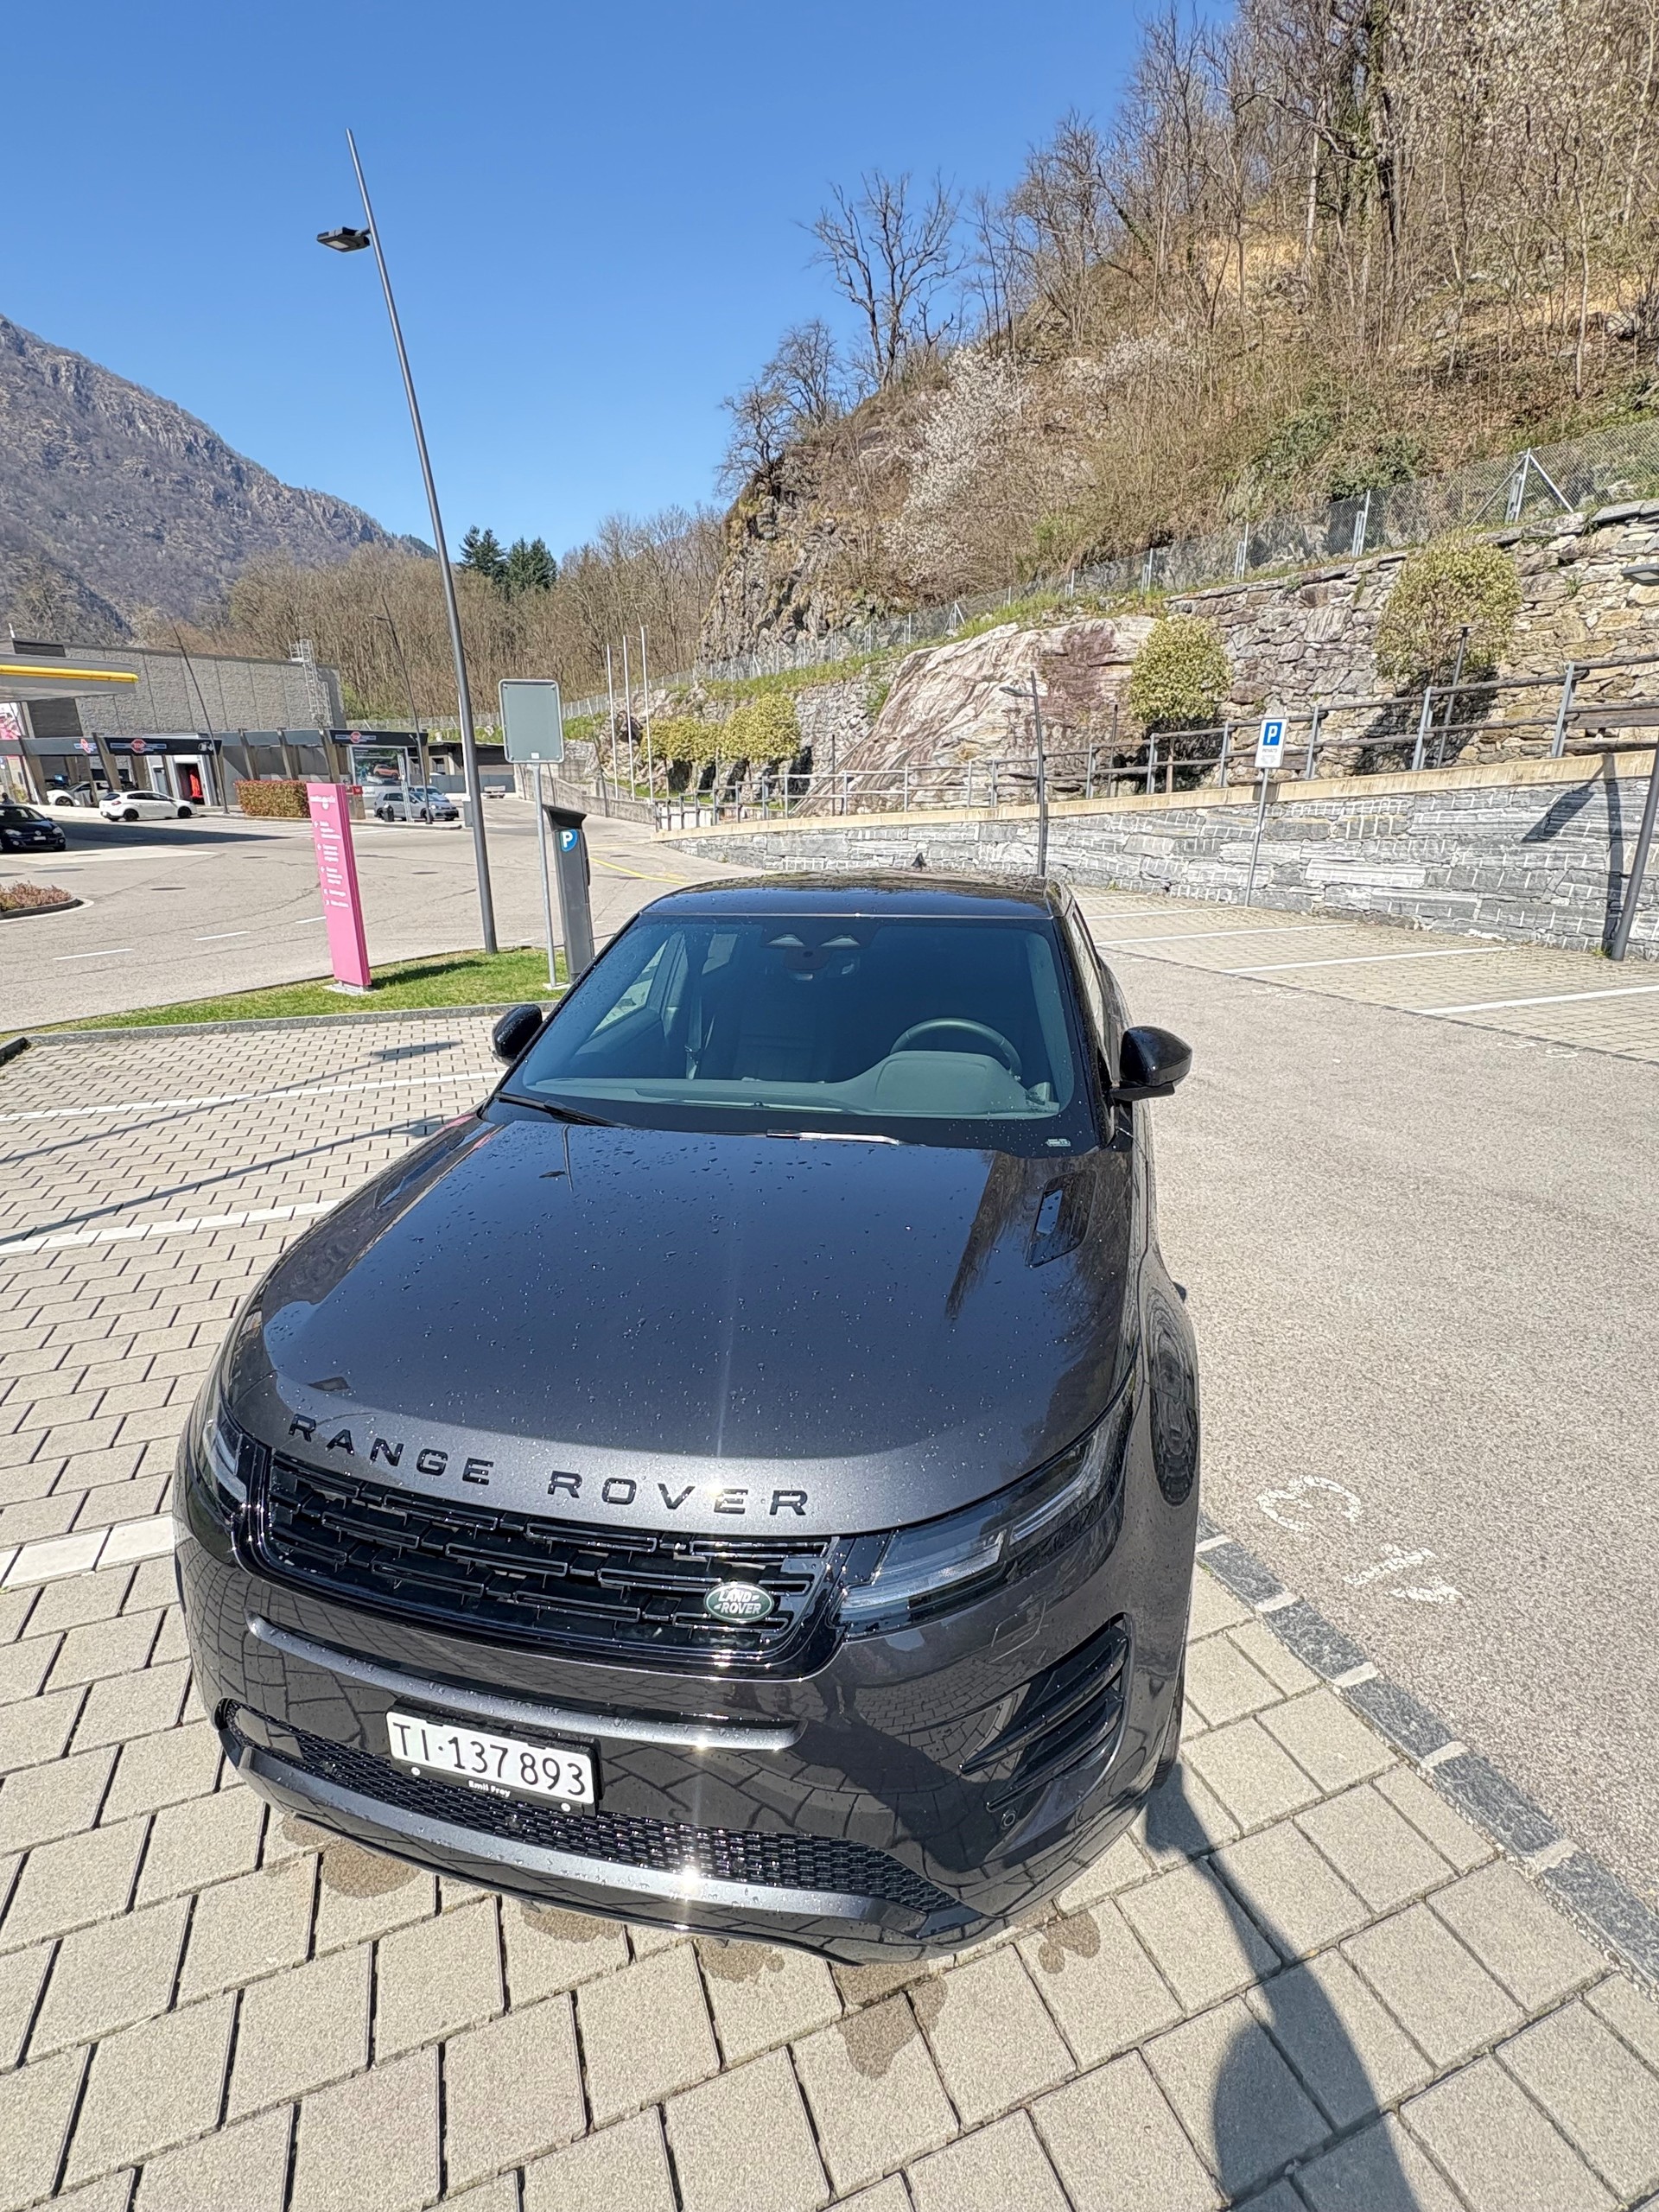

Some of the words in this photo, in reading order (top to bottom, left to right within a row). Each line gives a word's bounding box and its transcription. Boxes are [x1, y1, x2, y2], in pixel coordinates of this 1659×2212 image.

[1267, 725, 1279, 743] P
[562, 831, 574, 849] P
[288, 1413, 495, 1486] RANGE
[547, 1470, 809, 1516] ROVER
[718, 1588, 753, 1603] LAND
[720, 1602, 762, 1615] ROVER
[519, 1752, 586, 1796] 893
[468, 1780, 489, 1792] Emil
[490, 1785, 512, 1798] Frey
